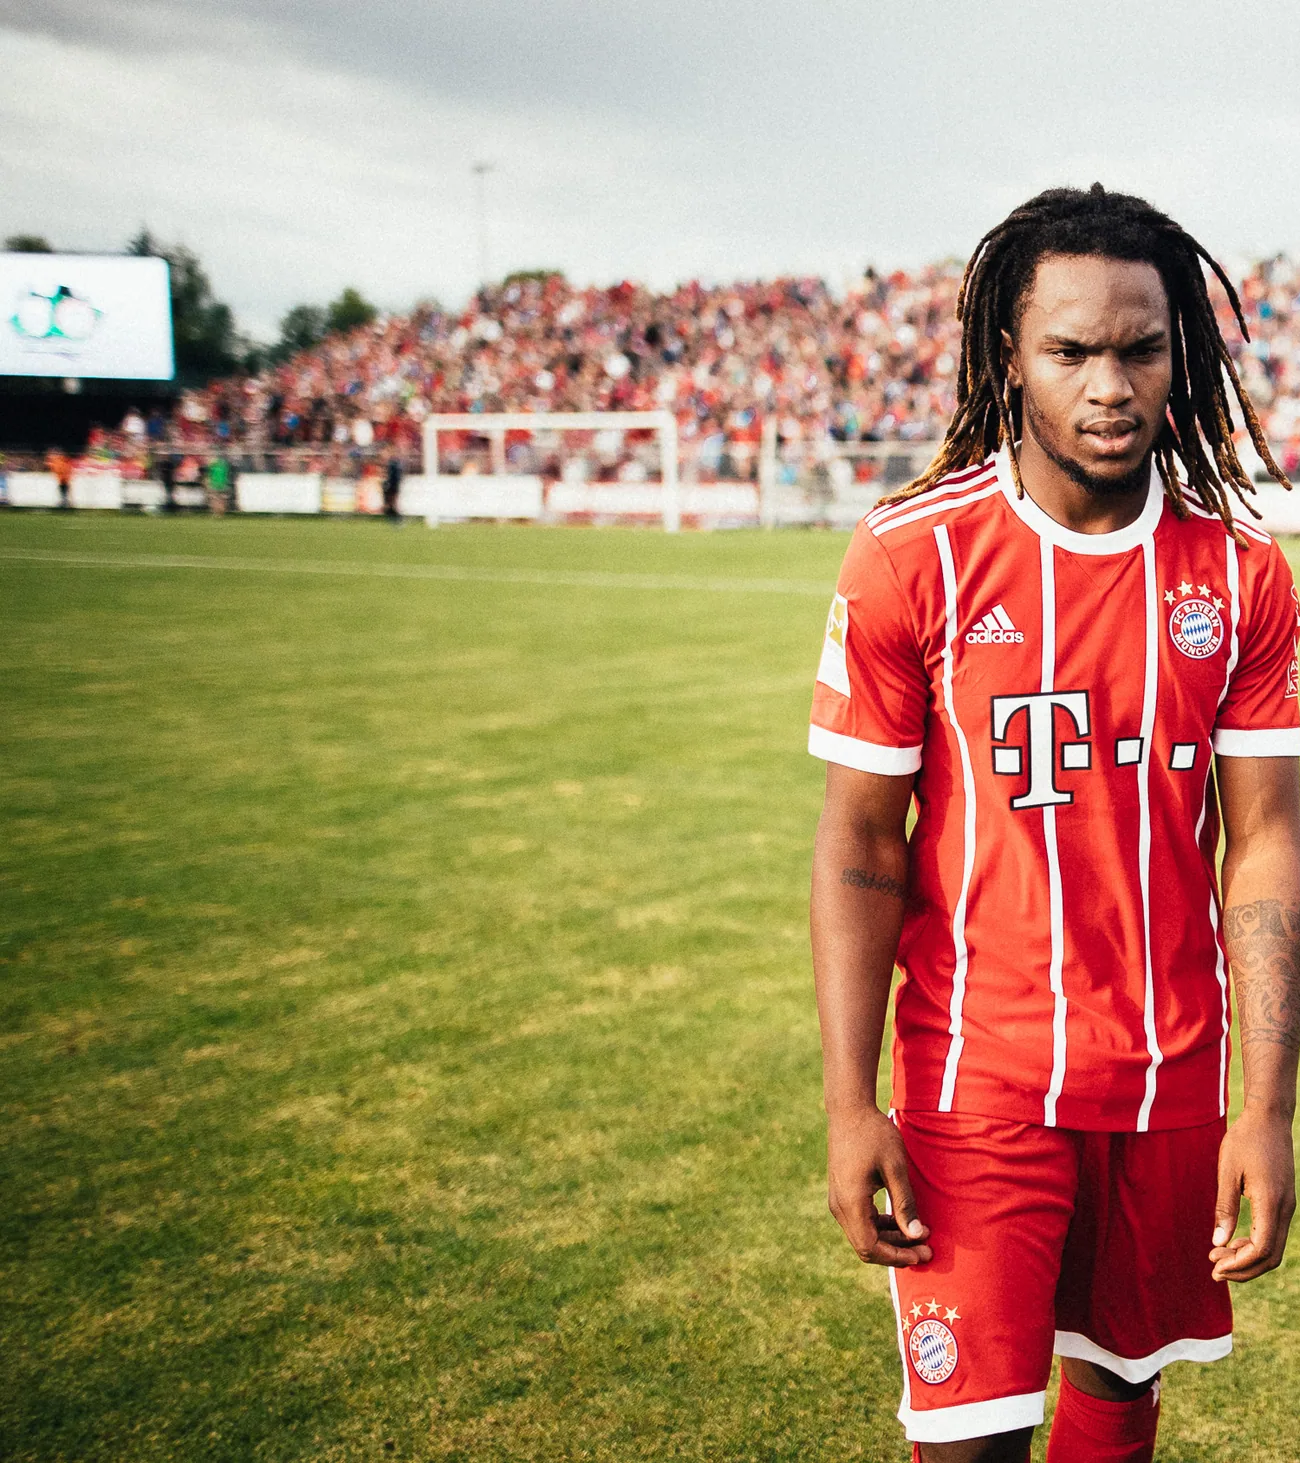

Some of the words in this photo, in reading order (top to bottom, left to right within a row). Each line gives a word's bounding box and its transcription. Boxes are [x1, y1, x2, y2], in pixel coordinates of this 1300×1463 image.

[1173, 610, 1185, 625] FC
[1183, 603, 1219, 627] BAYERN
[965, 629, 1025, 644] adidas
[912, 1336, 920, 1351] FC
[917, 1323, 953, 1345] BAYERN
